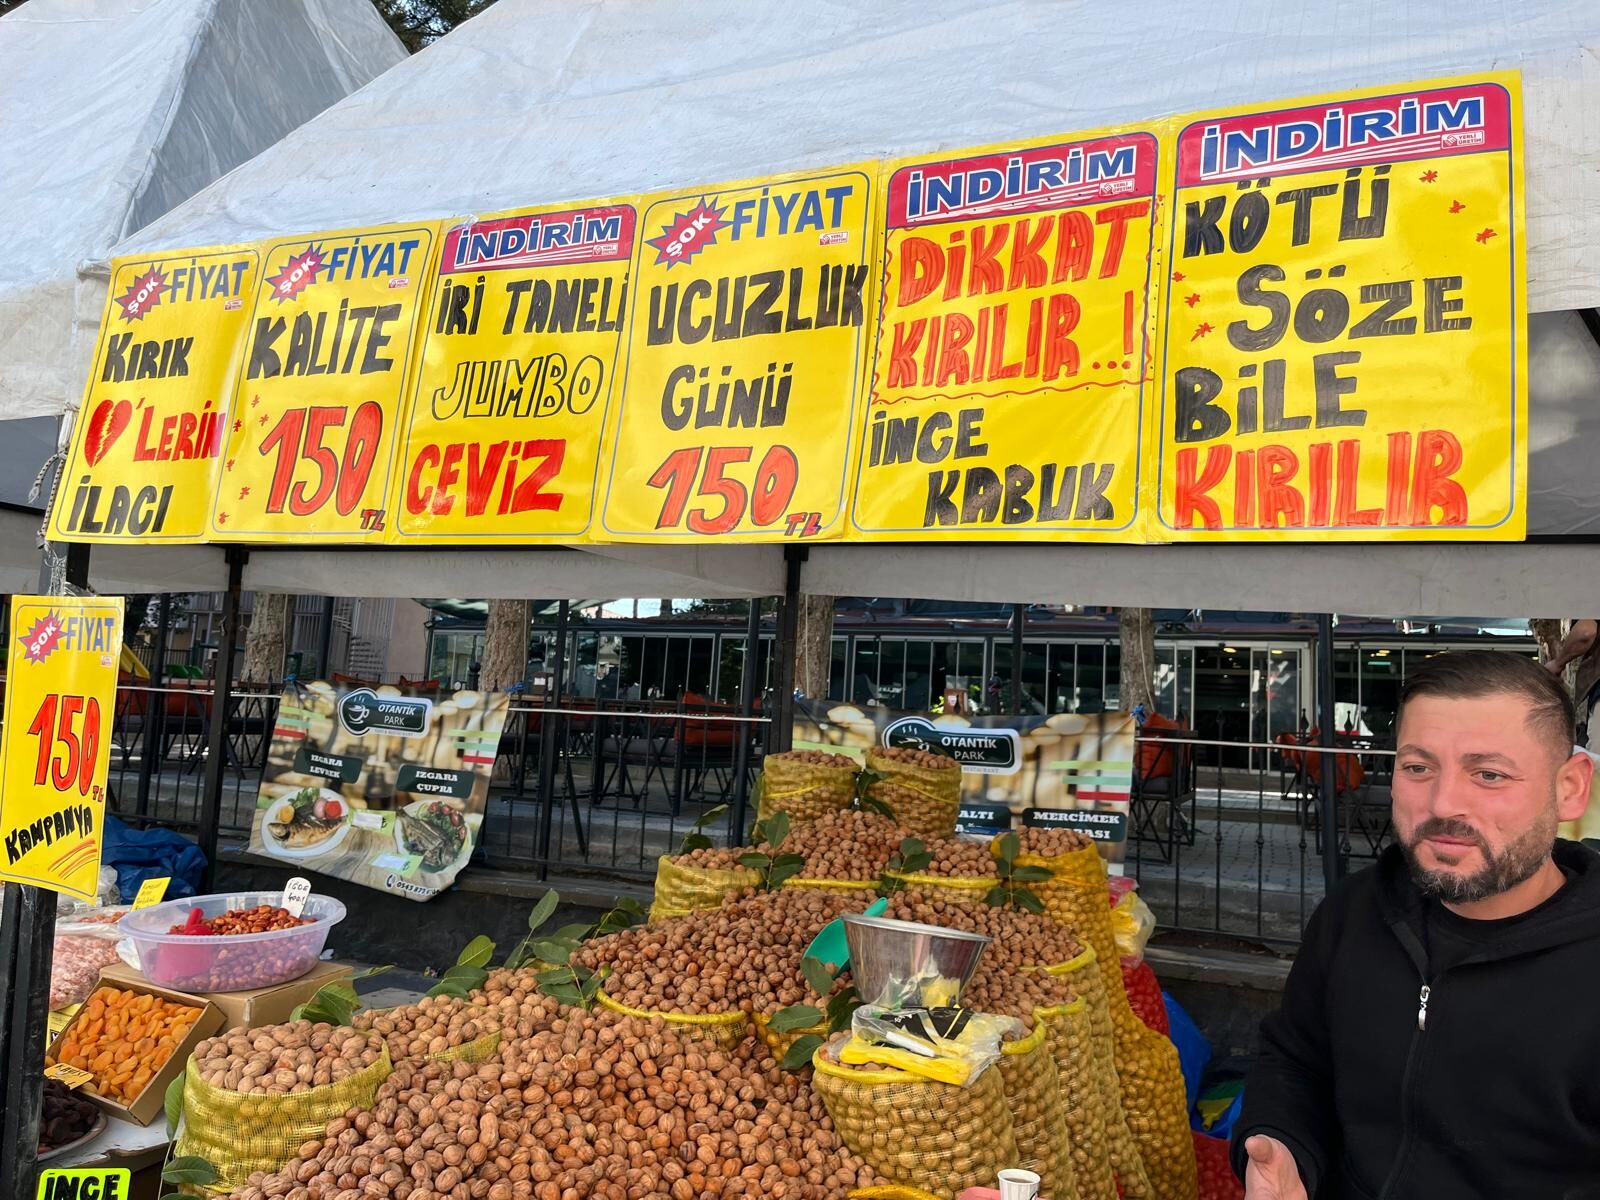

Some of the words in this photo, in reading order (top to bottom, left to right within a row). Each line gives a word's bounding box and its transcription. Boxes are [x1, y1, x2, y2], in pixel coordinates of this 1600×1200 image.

[1201, 96, 1485, 177] İNDİRİM
[905, 146, 1138, 219] İNDİRİM
[1182, 164, 1393, 259] KÖTÜ
[454, 214, 623, 268] İNDİRİM
[665, 211, 713, 258] ŞOK
[731, 185, 854, 241] FİYAT
[897, 200, 1151, 307] DİKKAT
[126, 276, 161, 315] ŞOK
[169, 258, 250, 303] FİYAT
[279, 254, 317, 295] ŞOK
[326, 238, 420, 282] FİYAT
[435, 275, 485, 336] İRİ
[502, 272, 628, 336] TANELİ
[646, 264, 869, 347] UCUZLUK
[1226, 263, 1473, 353] SÖZE
[101, 332, 195, 384] KIRIK
[246, 297, 403, 382] KALİTE
[431, 352, 604, 420] JUMBO
[660, 361, 794, 431] GÜNÜ
[1174, 351, 1368, 443] BİLE
[258, 400, 384, 517] 150
[405, 438, 567, 517] CEVİZ
[646, 444, 799, 535] 150
[1173, 430, 1469, 530] KIRILIR
[66, 475, 175, 535] İLACI
[923, 462, 1115, 527] KABUK
[30, 621, 57, 656] ŞOK
[65, 608, 115, 653] FİYAT
[378, 703, 417, 716] OTANTİK
[383, 715, 405, 726] PARK
[941, 736, 998, 749] OTANTİK
[27, 694, 101, 796] 150
[415, 770, 459, 783] IZGARA
[954, 750, 985, 761] PARK
[416, 783, 453, 795] ÇUPRA
[958, 809, 994, 820] ALTI
[1032, 811, 1120, 825] MERCİMEK
